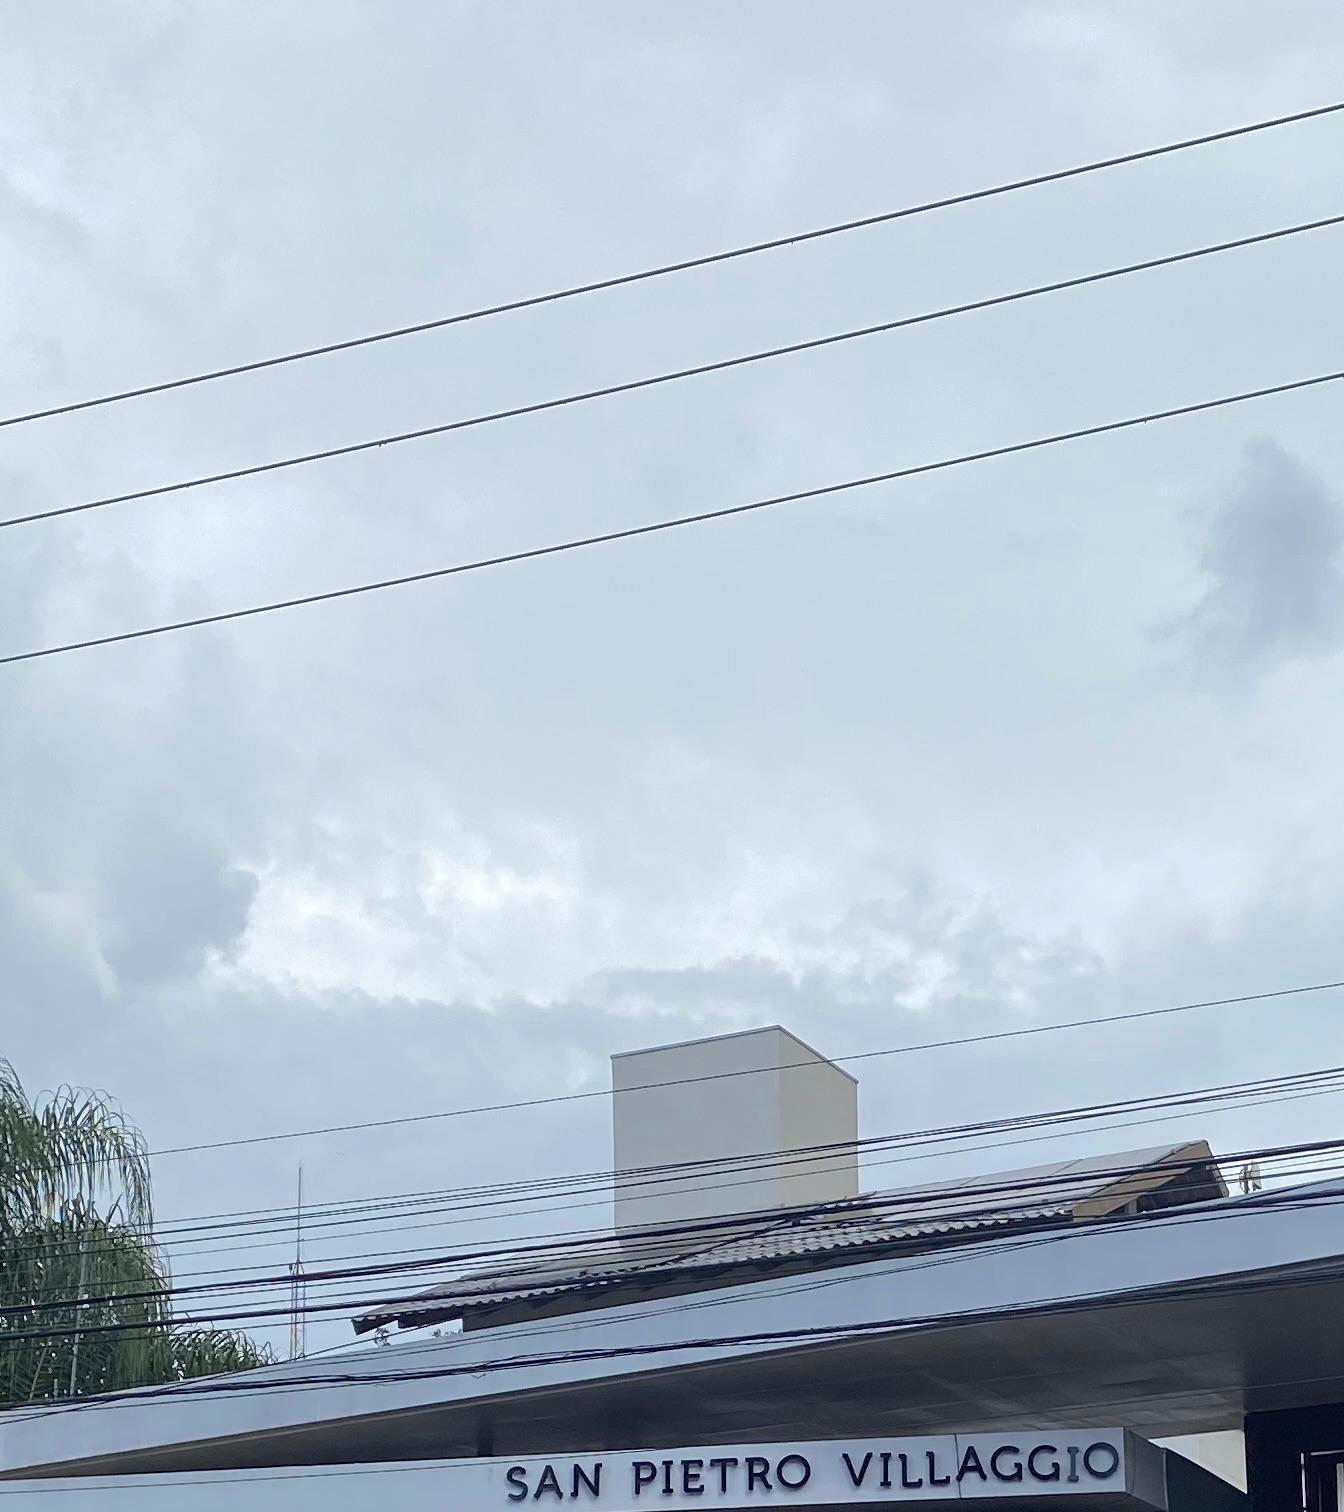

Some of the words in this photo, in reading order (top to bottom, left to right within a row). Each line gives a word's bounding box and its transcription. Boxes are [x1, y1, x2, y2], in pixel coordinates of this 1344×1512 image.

[505, 1463, 602, 1501] SAN
[631, 1454, 811, 1496] PIETRO
[841, 1442, 1120, 1488] VILLAGGIO
